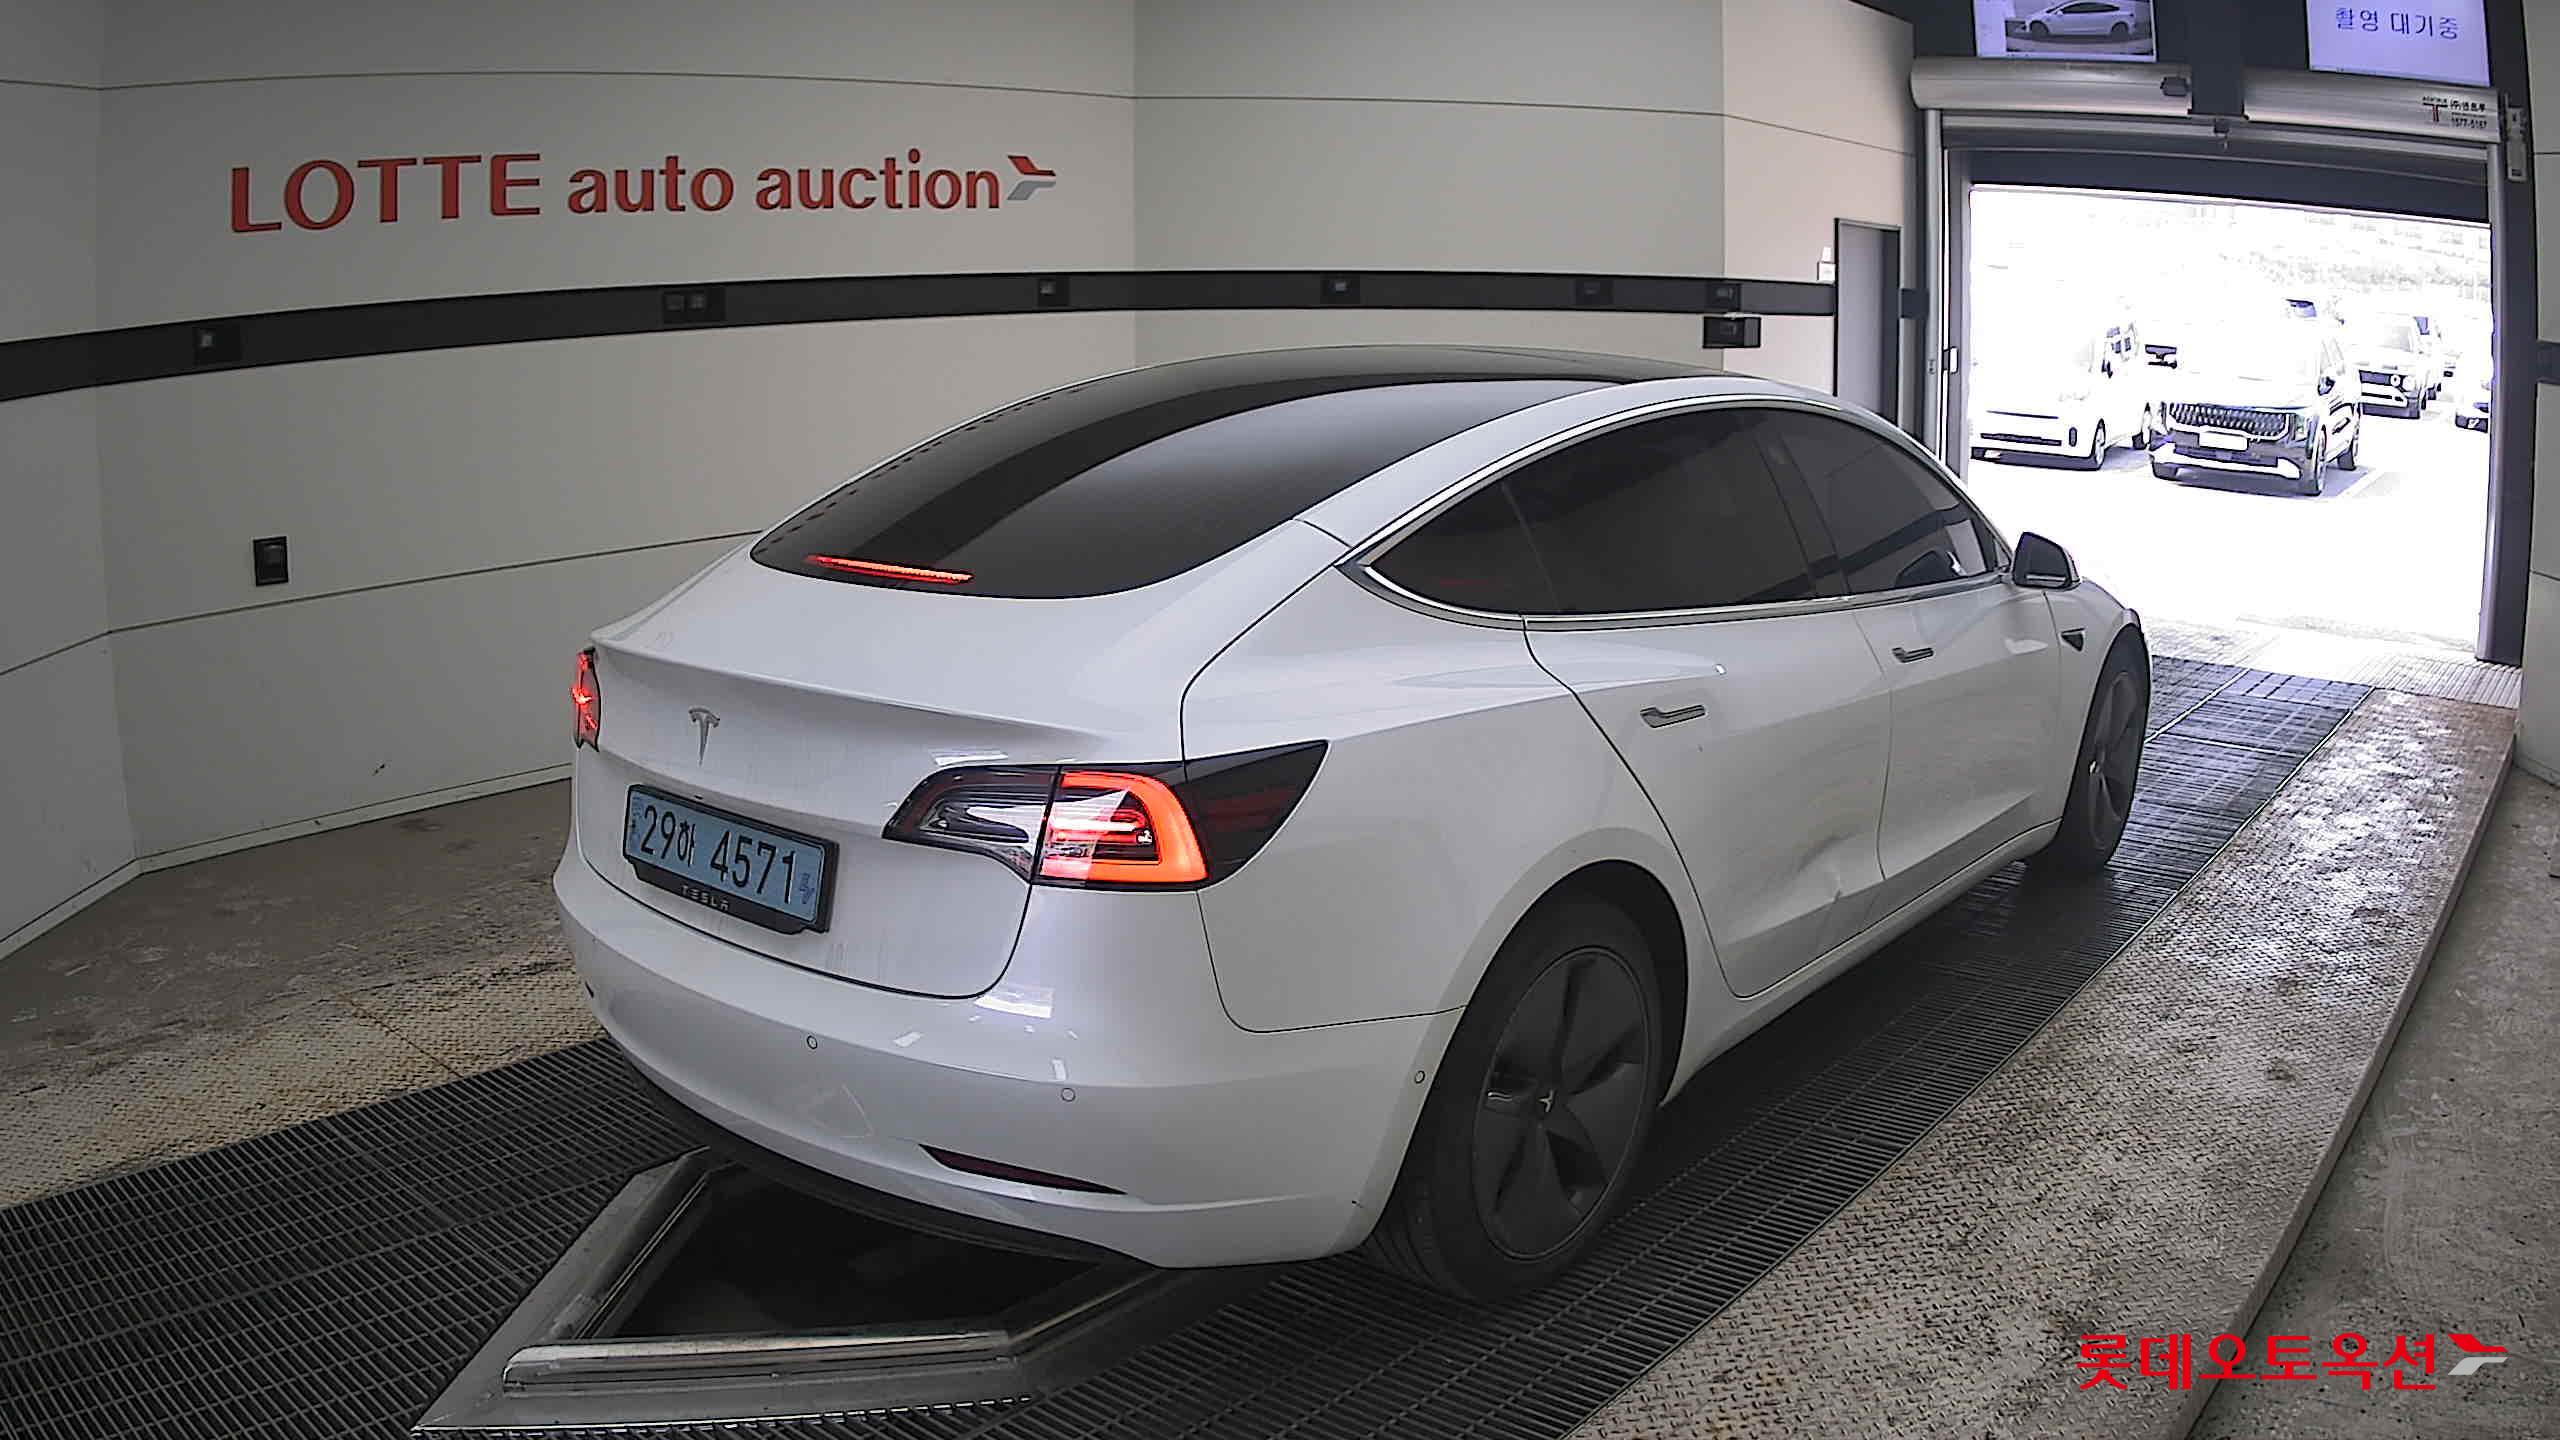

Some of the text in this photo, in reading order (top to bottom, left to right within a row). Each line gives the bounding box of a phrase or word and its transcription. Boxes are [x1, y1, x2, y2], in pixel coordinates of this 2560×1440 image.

[2336, 7, 2458, 40] 촬영 대기중
[230, 148, 1002, 232] LOTTE auto auction
[640, 805, 696, 867] 29하
[710, 831, 797, 904] 4571
[680, 884, 730, 911] TESLA
